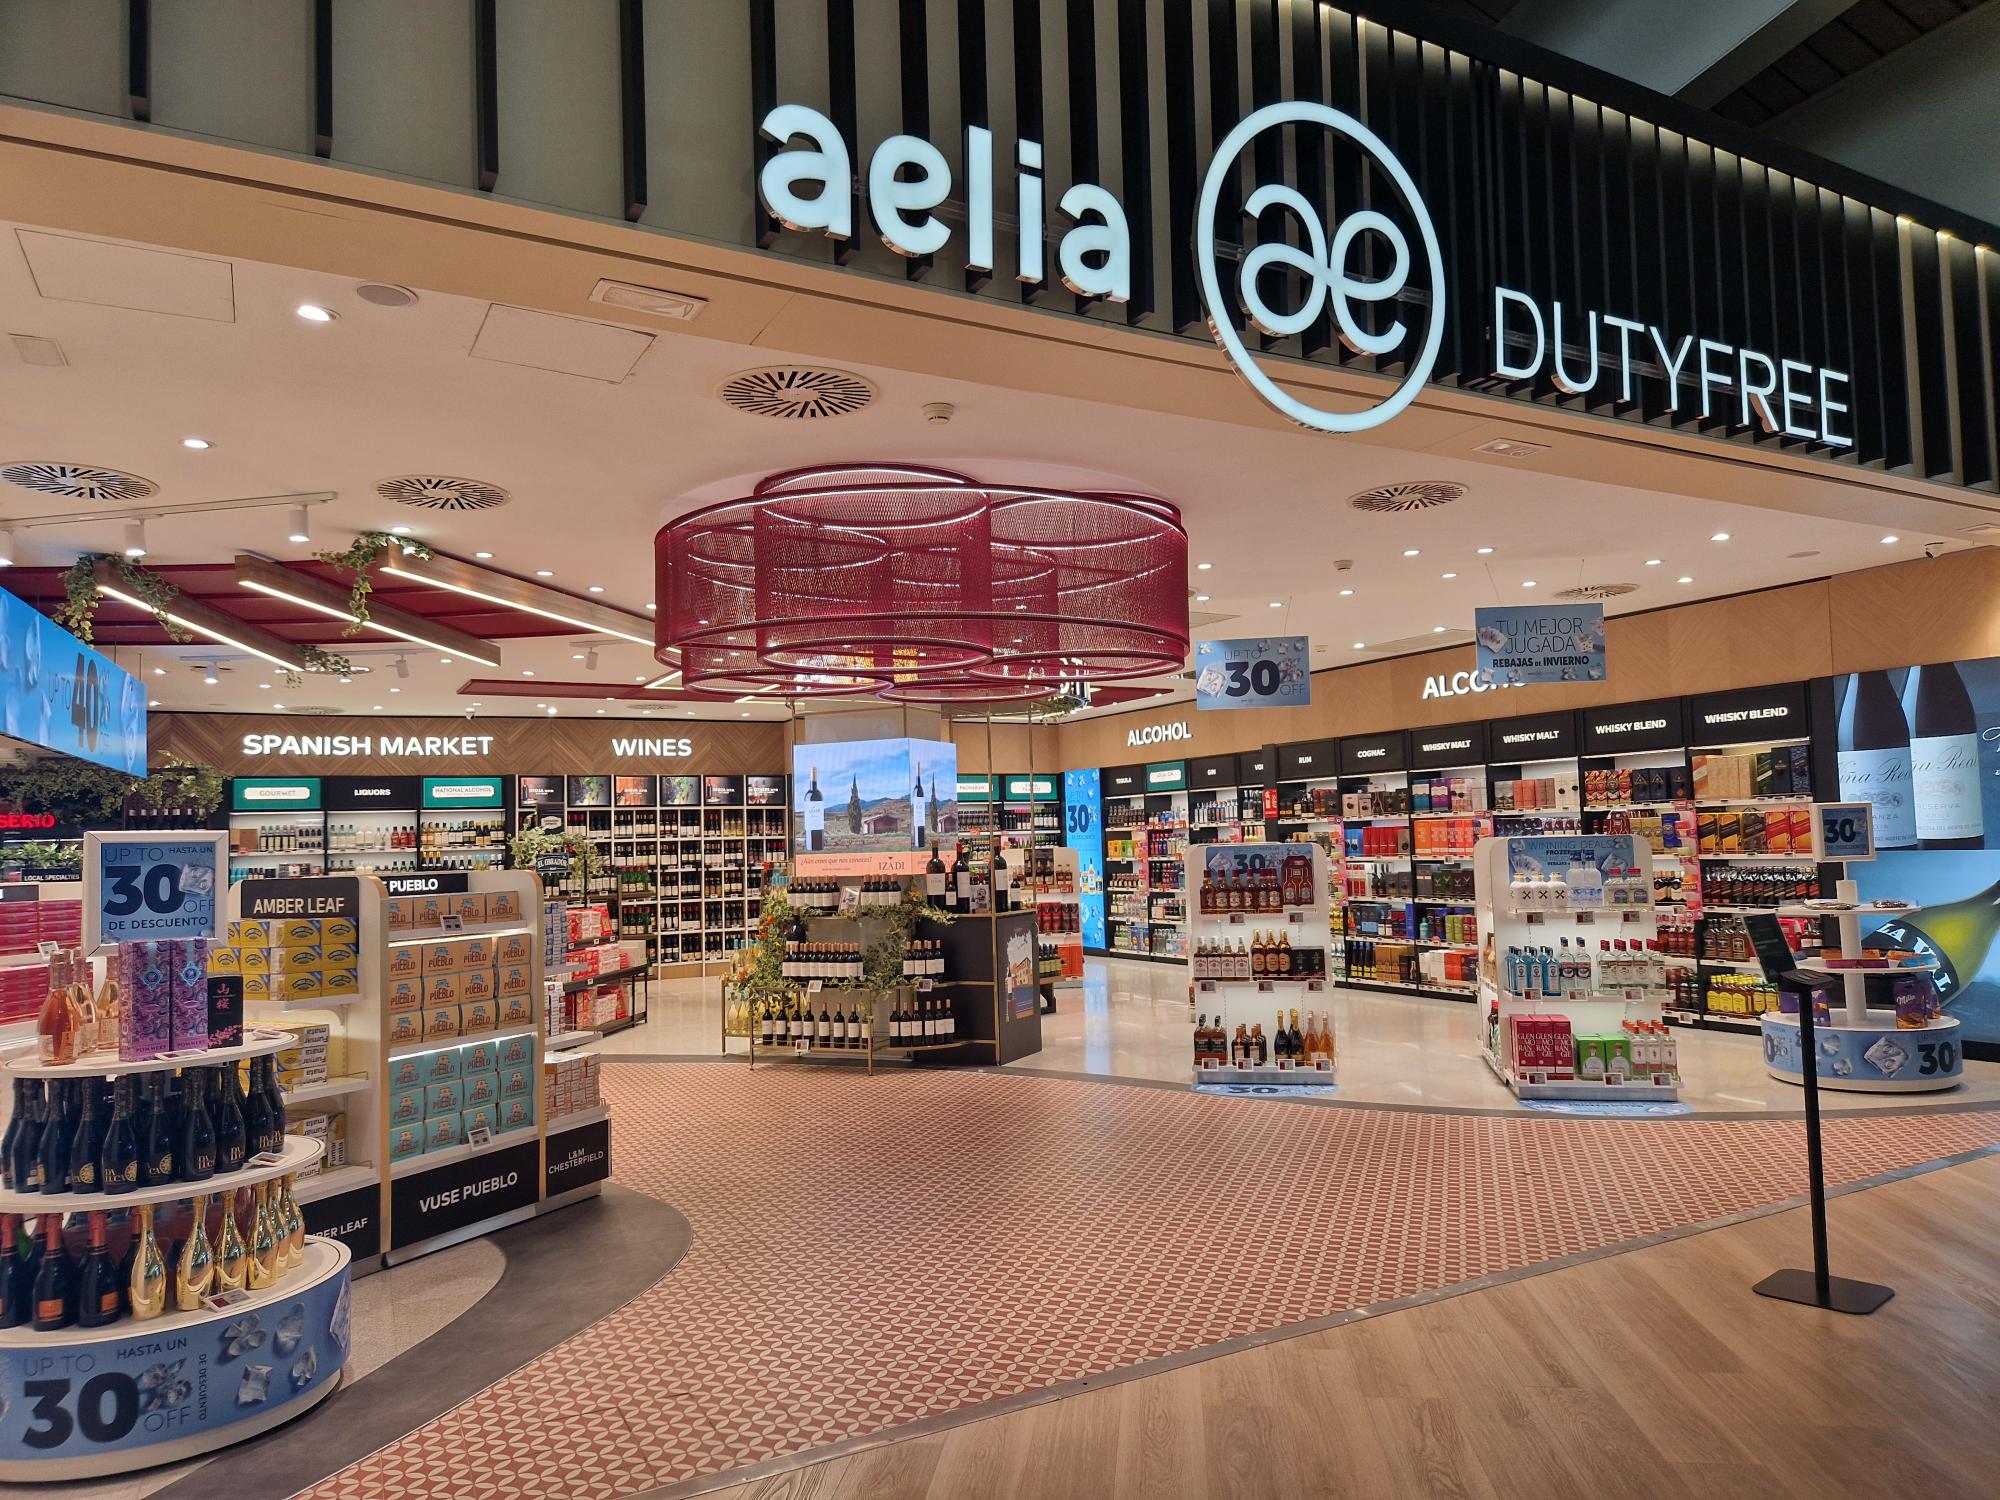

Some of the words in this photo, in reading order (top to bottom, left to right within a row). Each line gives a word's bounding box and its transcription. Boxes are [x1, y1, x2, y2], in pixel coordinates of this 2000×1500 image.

[759, 103, 1131, 303] aelia
[1494, 287, 1853, 447] DUTYFREE
[1496, 619, 1519, 637] TU
[1524, 617, 1583, 636] MEJOR
[1505, 635, 1576, 655] JUGADA
[1224, 650, 1241, 660] UP
[1242, 649, 1262, 659] TO
[1492, 657, 1534, 668] REBAJAS
[1543, 655, 1589, 667] INVIERNO
[1225, 659, 1280, 697] 30
[1279, 683, 1305, 696] OFF
[1704, 711, 1748, 724] WHISKY
[1749, 707, 1788, 720] BLEND
[1127, 721, 1193, 747] ALCOHOL
[1595, 722, 1633, 735] WHISKY
[1633, 719, 1666, 731] BLEND
[242, 734, 371, 756] SPANISH
[380, 736, 494, 756] MARKET
[1503, 733, 1535, 744] WHISKY
[1536, 730, 1560, 741] MALT
[611, 738, 692, 757] WINES
[1357, 748, 1386, 758] COGNAC
[1422, 741, 1450, 752] WHISKY
[1451, 740, 1471, 749] MALT
[1298, 756, 1312, 764] RUM
[354, 788, 391, 796] LIQUORS
[1067, 803, 1089, 833] 30
[1823, 818, 1857, 844] 30
[1528, 840, 1576, 850] WINNING
[1580, 839, 1613, 849] DEALS
[104, 847, 131, 863] UP
[136, 847, 164, 862] TO
[169, 846, 198, 854] HASTA
[878, 861, 905, 871] IZADI
[1233, 853, 1266, 875] 30
[103, 863, 186, 917] 30
[389, 878, 439, 893] PUEBLO
[253, 898, 305, 915] AMBER
[307, 896, 345, 914] LEAF
[108, 920, 126, 931] DE
[131, 916, 208, 929] DESCUENTO
[464, 953, 487, 963] PUEBLO
[503, 949, 525, 958] PUEBLO
[391, 960, 415, 973] PUEBLO
[429, 958, 453, 967] PUEBLO
[465, 984, 489, 995] PUEBLO
[504, 980, 525, 989] PUEBLO
[391, 995, 415, 1006] PUEBLO
[430, 990, 453, 1000] PUEBLO
[1917, 1041, 1955, 1076] 30
[548, 1150, 604, 1174] CHESTERFIELD
[568, 1147, 585, 1160] L&M
[419, 1188, 460, 1214] VUSE
[462, 1171, 518, 1202] PUEBLO
[339, 1217, 368, 1236] LEAF
[116, 1342, 162, 1361] HASTA
[166, 1336, 188, 1353] UN
[23, 1355, 55, 1376] UP
[59, 1352, 96, 1374] TO
[22, 1370, 141, 1450] 30
[143, 1406, 192, 1433] OFF
